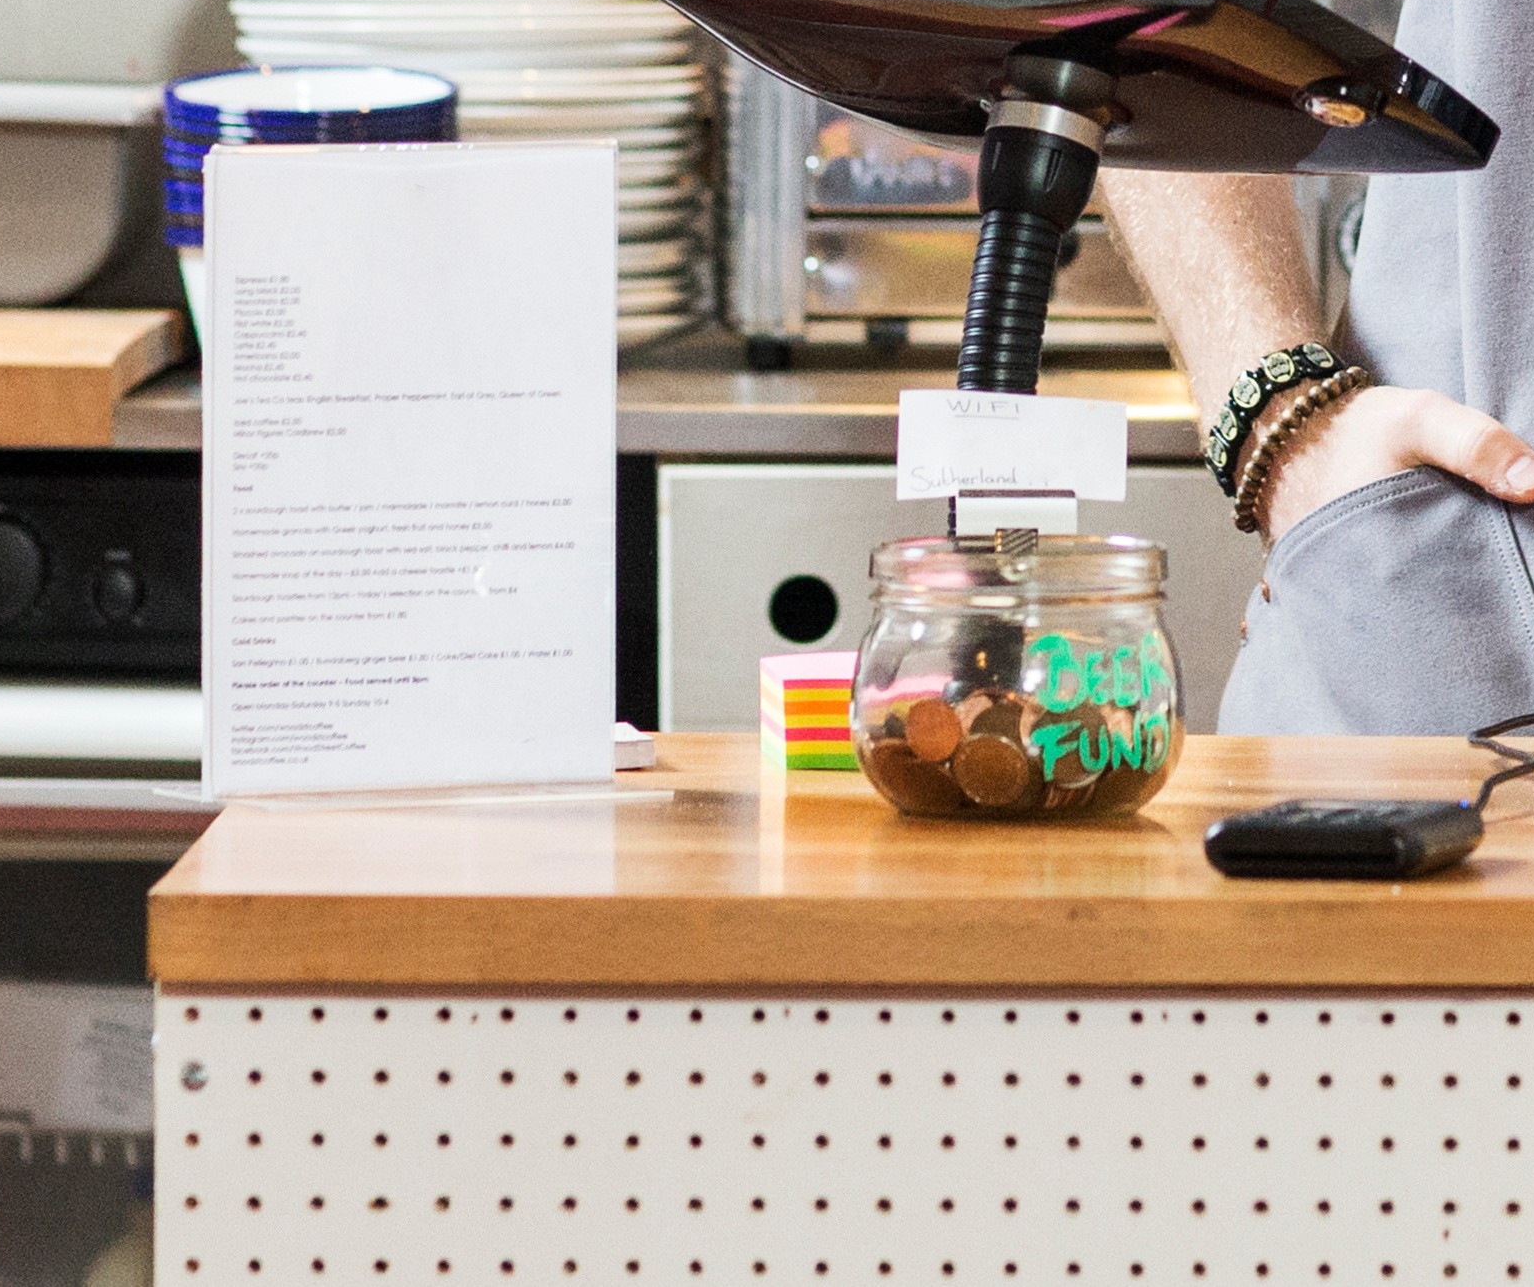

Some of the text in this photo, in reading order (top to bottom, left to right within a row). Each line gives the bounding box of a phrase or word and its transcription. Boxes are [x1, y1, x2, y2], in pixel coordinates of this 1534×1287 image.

[946, 398, 1019, 414] WIFI
[1027, 633, 1172, 714] BEER
[1030, 711, 1170, 782] FUND
